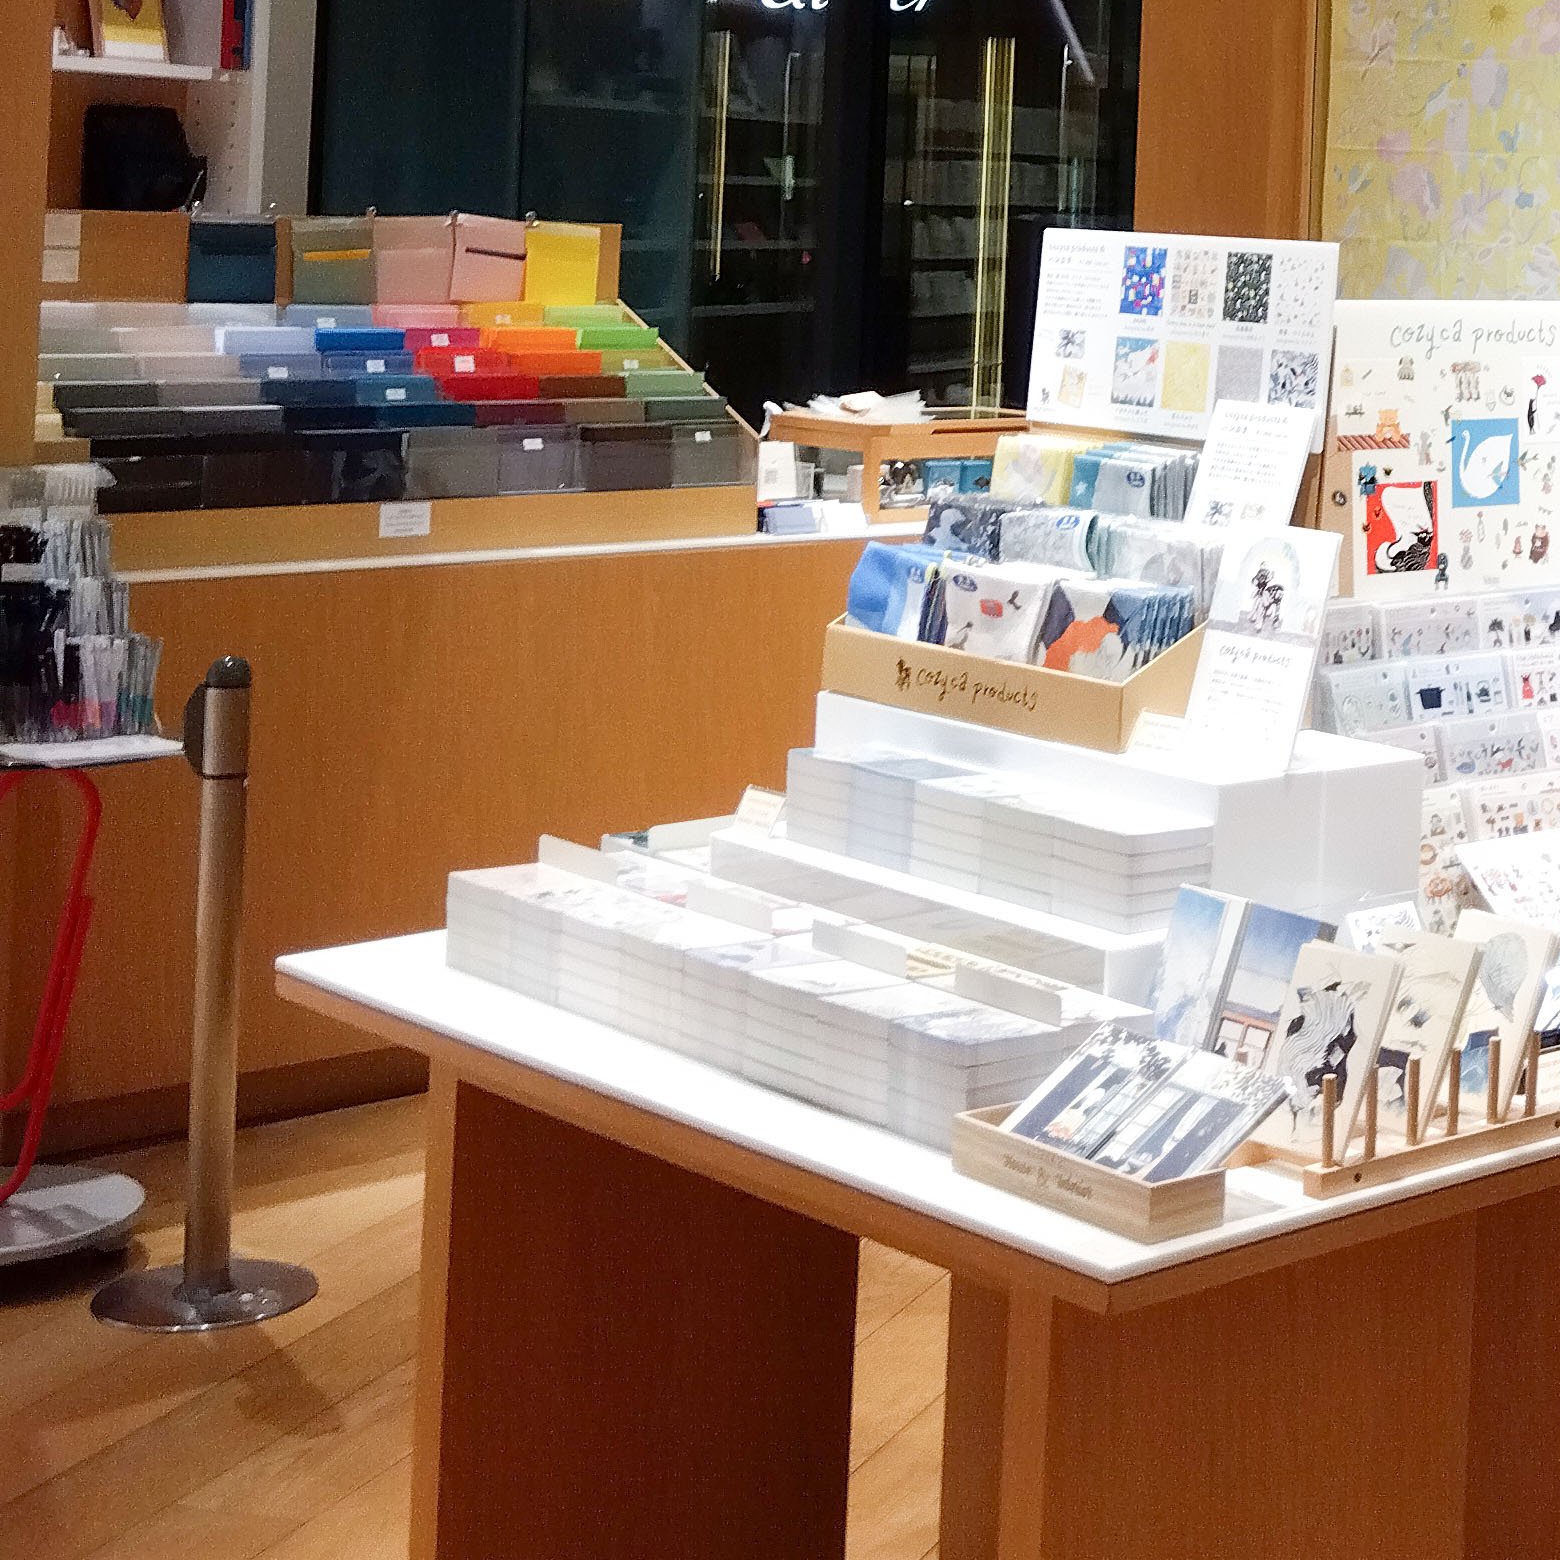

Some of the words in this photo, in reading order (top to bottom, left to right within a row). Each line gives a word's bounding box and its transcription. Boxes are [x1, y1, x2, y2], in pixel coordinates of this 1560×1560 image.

[1390, 319, 1464, 359] cozyca
[1472, 319, 1557, 354] products
[916, 668, 968, 701] cozyca
[973, 680, 1038, 712] products
